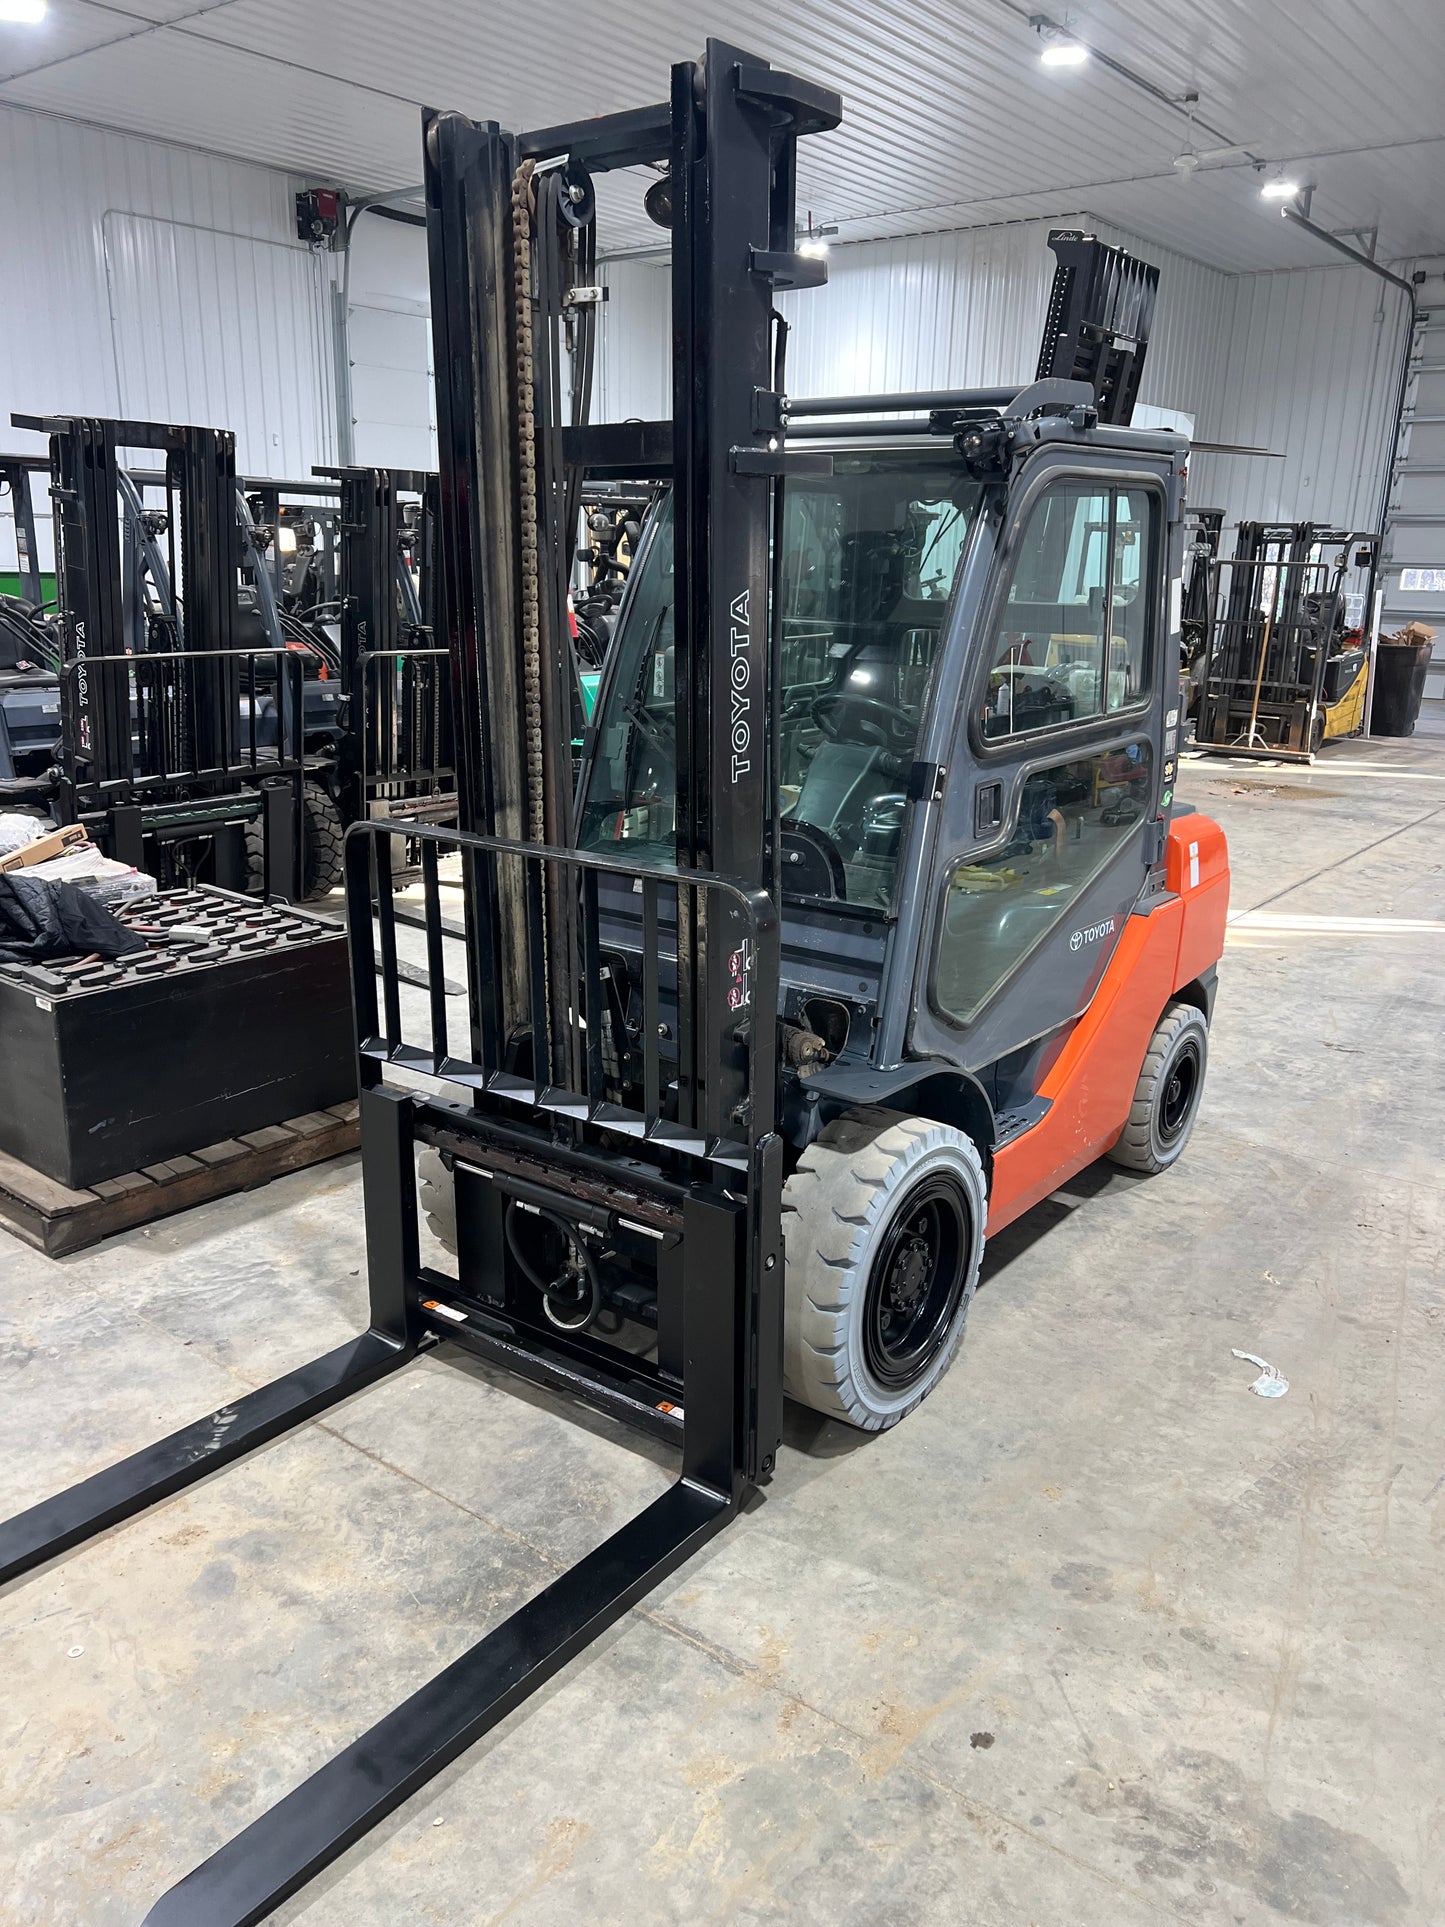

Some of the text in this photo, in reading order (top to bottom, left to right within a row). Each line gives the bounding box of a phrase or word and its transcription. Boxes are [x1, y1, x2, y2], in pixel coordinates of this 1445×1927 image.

[1051, 231, 1078, 242] Linde
[357, 620, 367, 656] OTA
[730, 588, 750, 784] TOYOTA
[1083, 919, 1115, 944] TOYOTA
